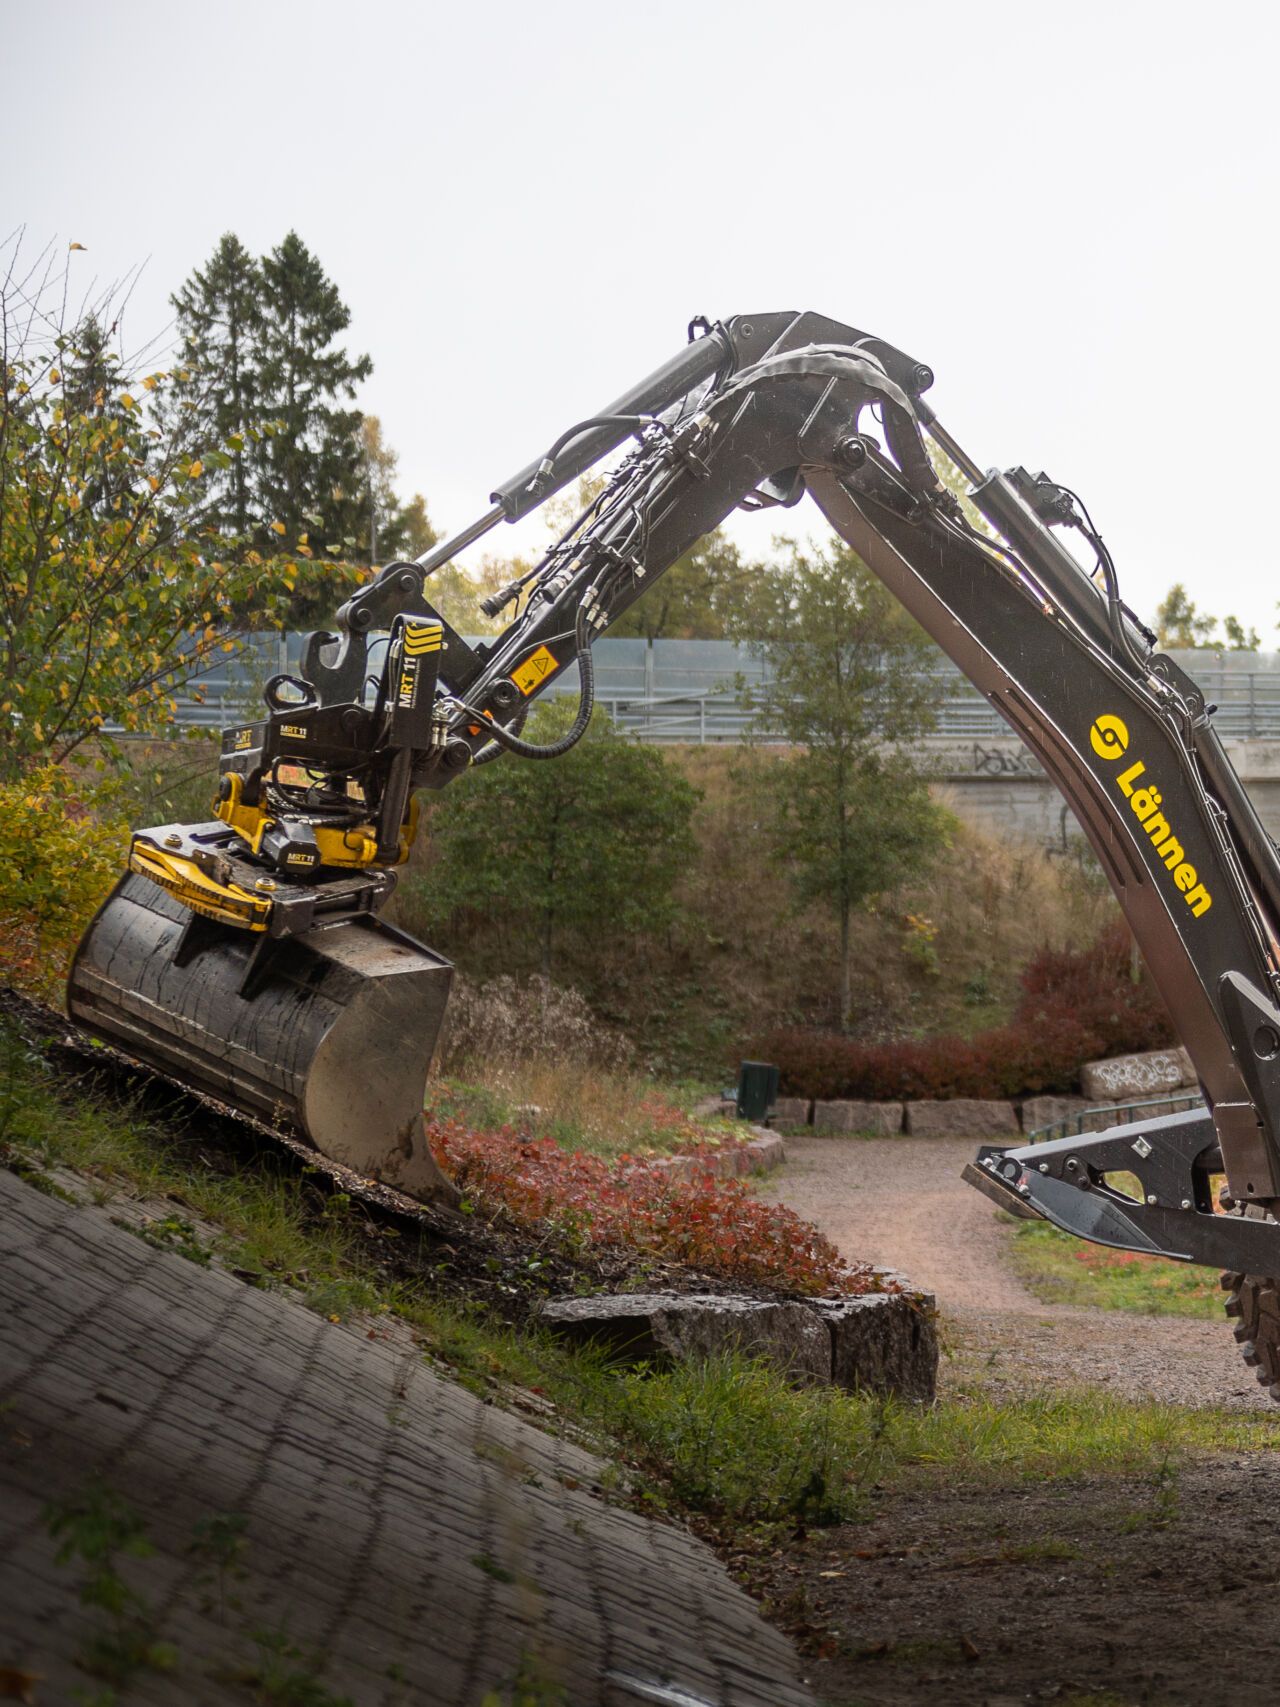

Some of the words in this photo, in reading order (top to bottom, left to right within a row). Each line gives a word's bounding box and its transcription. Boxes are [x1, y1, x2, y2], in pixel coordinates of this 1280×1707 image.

[404, 657, 417, 671] 11
[399, 673, 414, 708] MRT
[280, 724, 298, 734] MRT
[299, 728, 307, 736] 11
[1116, 760, 1213, 918] Lännen
[287, 853, 306, 861] MRT
